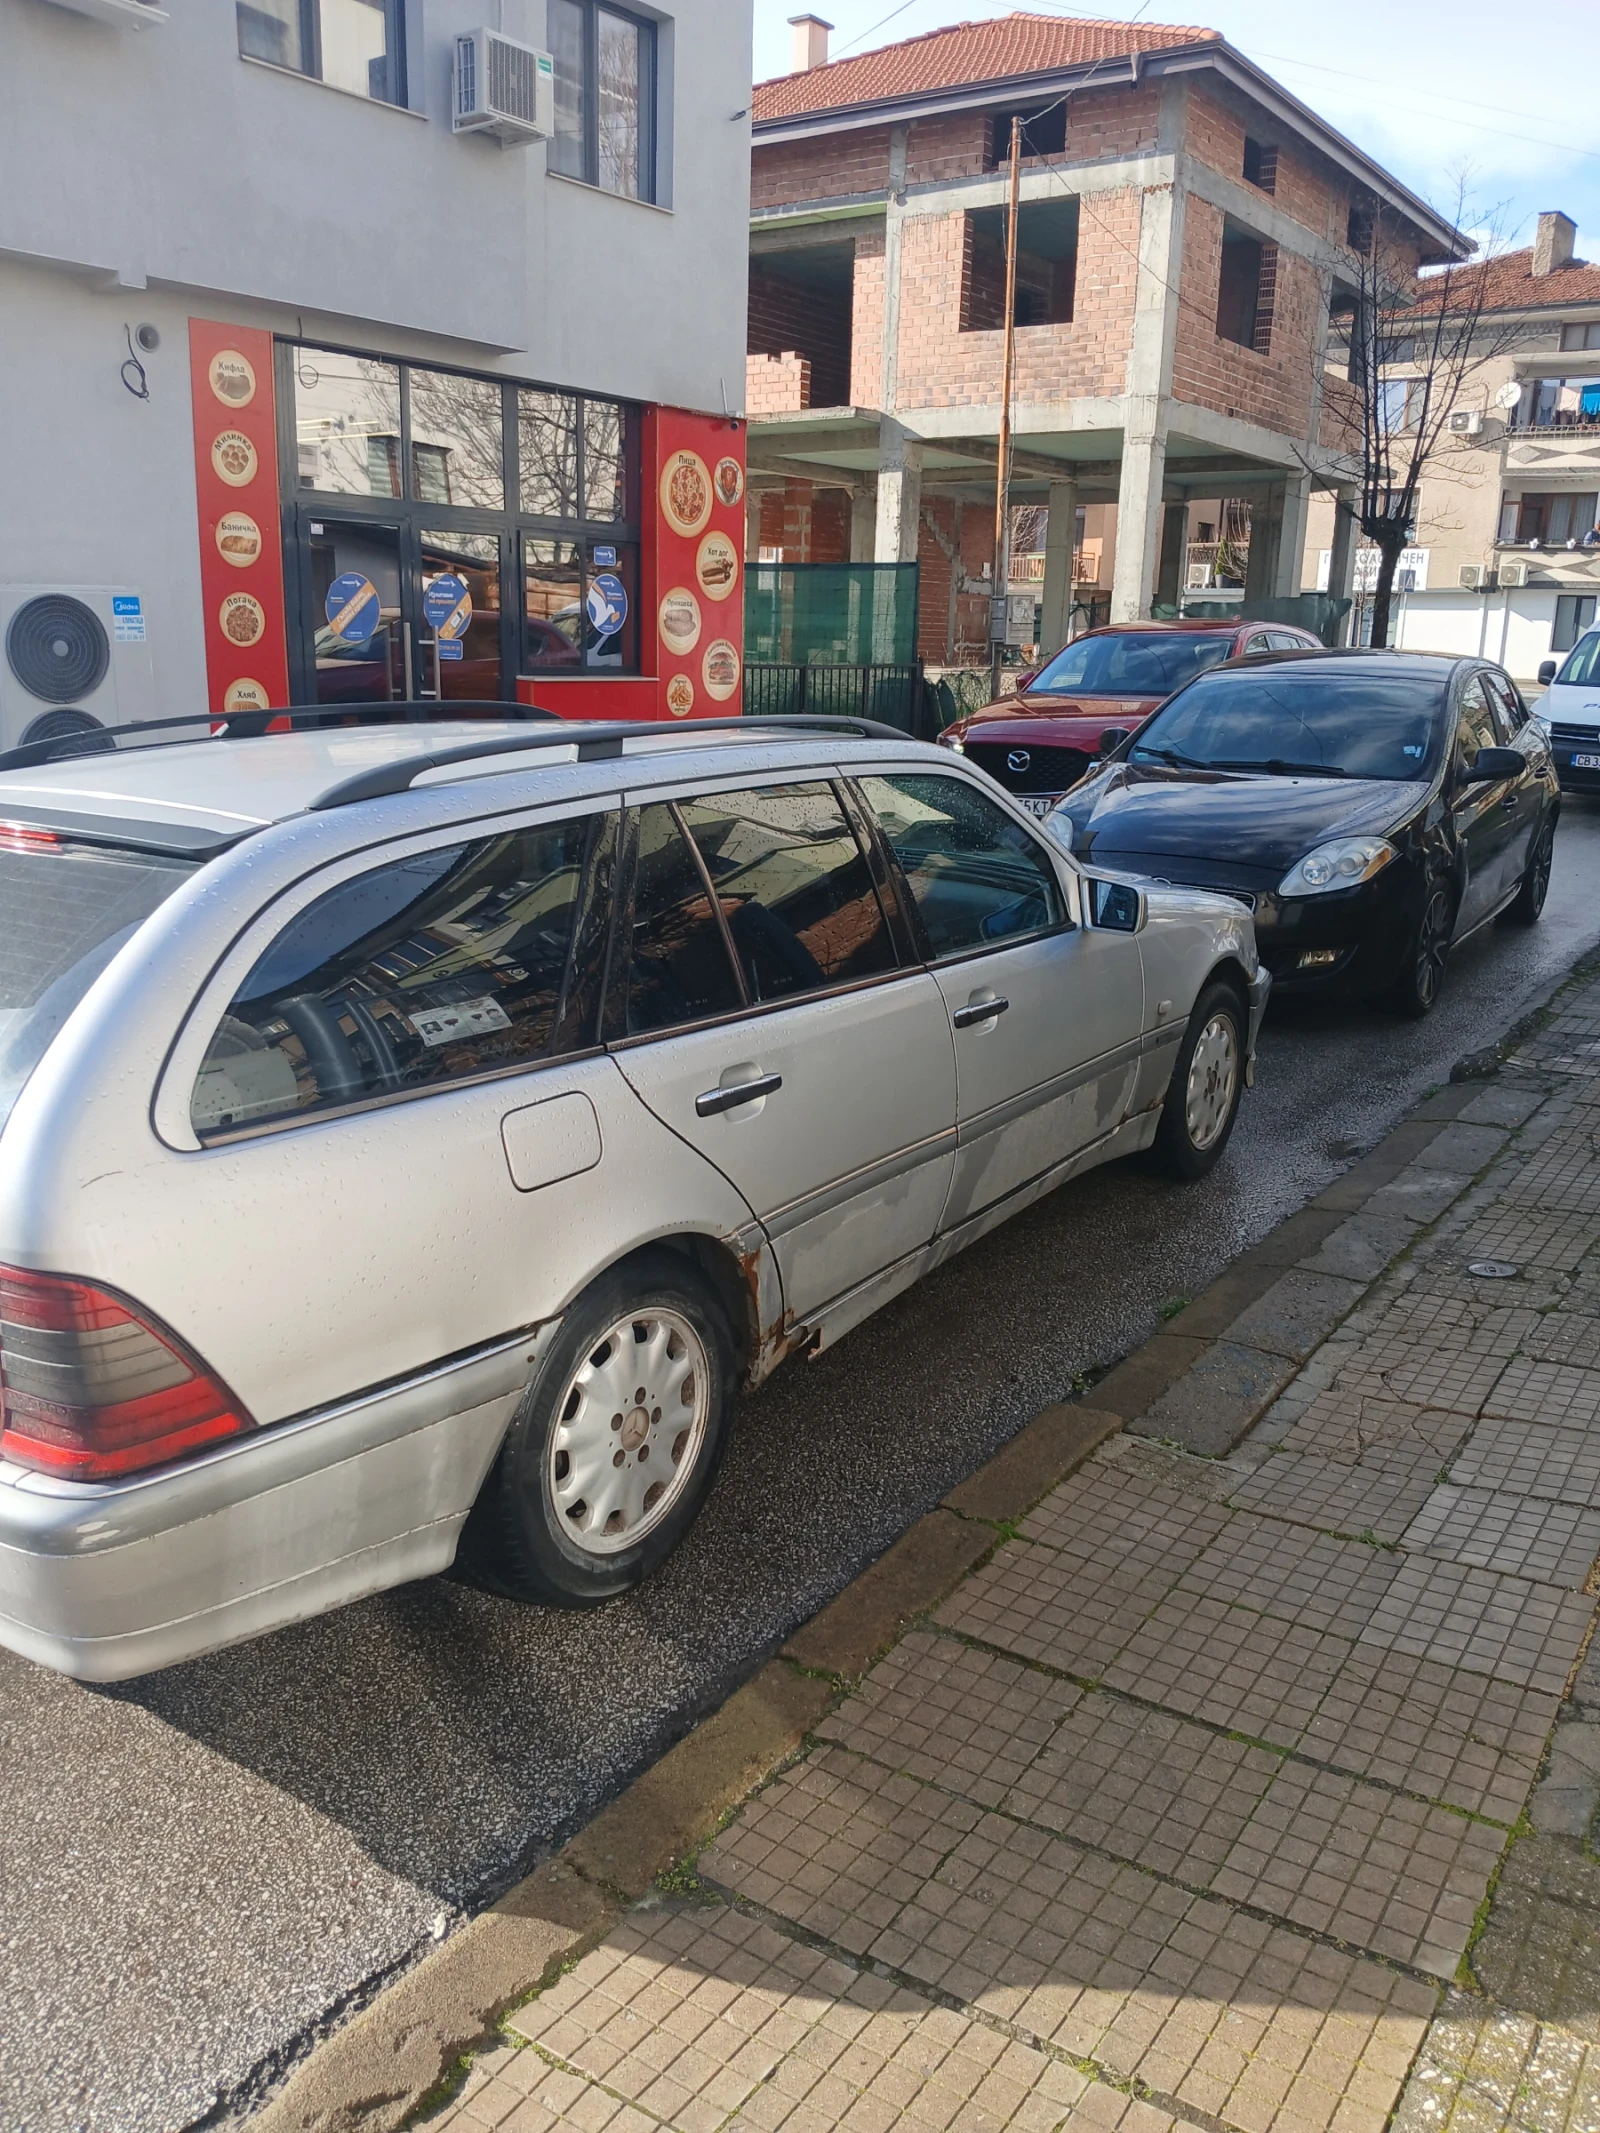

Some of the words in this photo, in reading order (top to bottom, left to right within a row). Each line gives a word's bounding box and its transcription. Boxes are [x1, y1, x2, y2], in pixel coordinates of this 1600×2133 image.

[218, 361, 245, 373] Кифла
[214, 433, 252, 451] Милинка
[678, 454, 696, 467] Пица
[221, 521, 257, 533] Баничка
[707, 547, 718, 556] Хот
[718, 550, 729, 558] дог
[115, 601, 139, 611] Midea
[226, 596, 257, 608] Погача
[667, 598, 693, 607] Принцеса
[237, 690, 257, 699] Хляб
